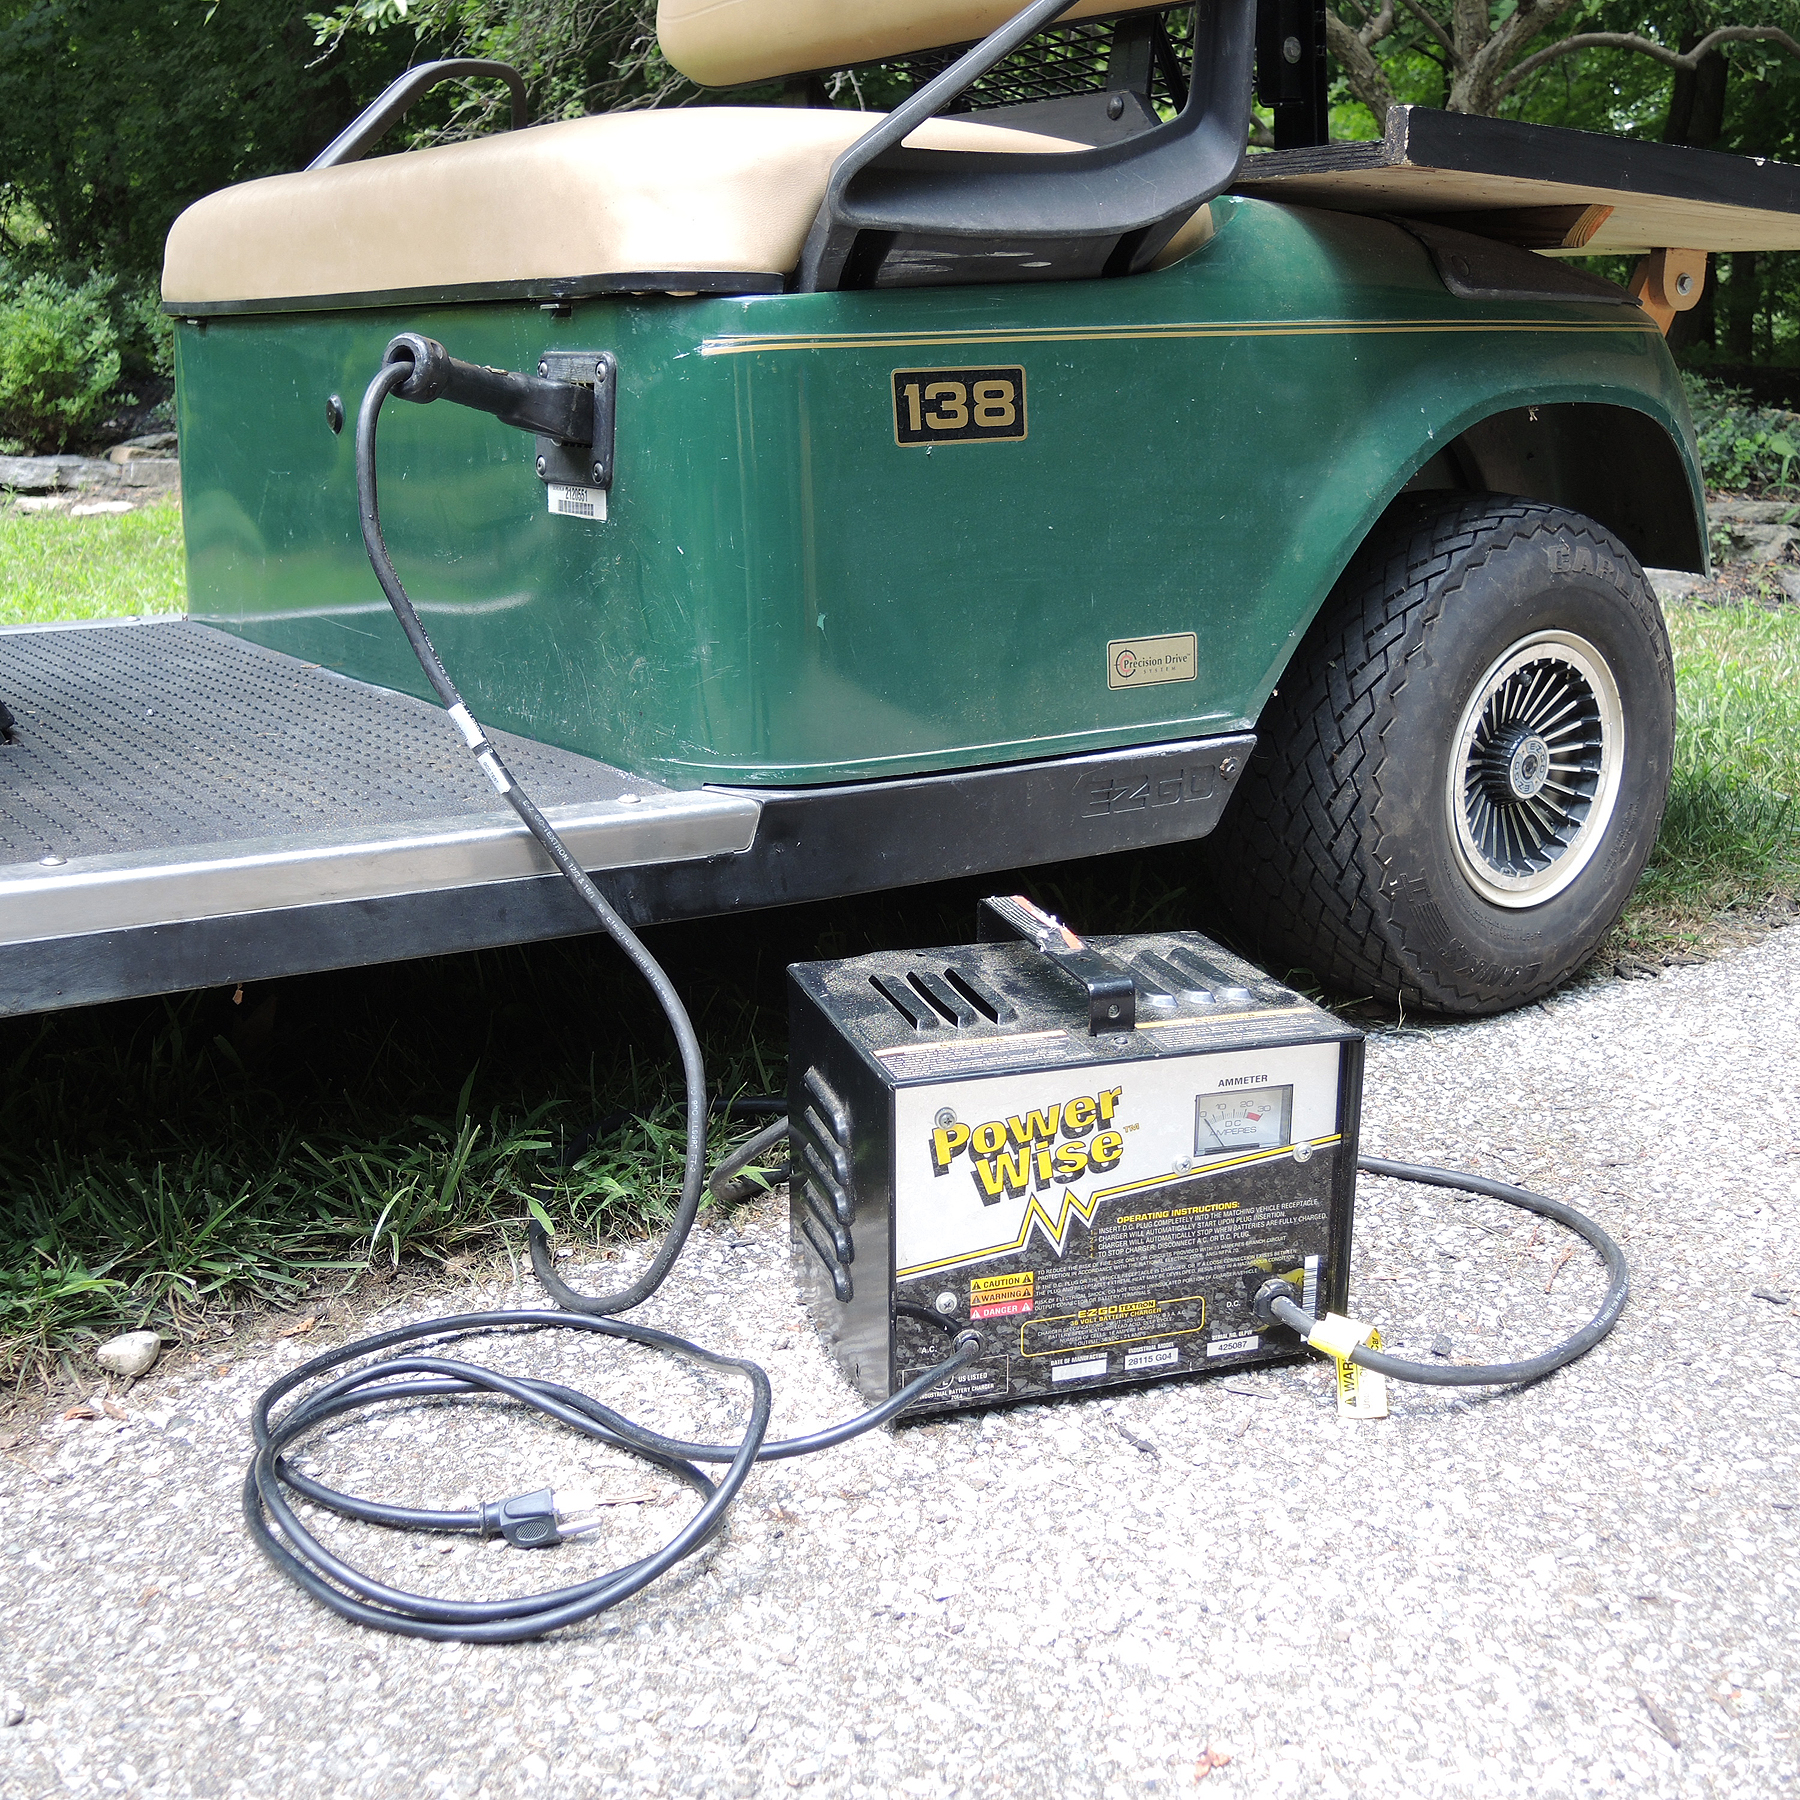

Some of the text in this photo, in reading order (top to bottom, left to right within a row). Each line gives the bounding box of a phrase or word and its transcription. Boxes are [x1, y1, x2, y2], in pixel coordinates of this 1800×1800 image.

[904, 380, 1016, 431] 138
[1123, 654, 1188, 669] Precision Drive
[1143, 666, 1177, 674] SYSTEM
[1218, 1074, 1267, 1086] AMMETER
[932, 1086, 1123, 1166] Power
[1209, 1125, 1256, 1138] AMPERES
[974, 1130, 1124, 1196] Wise
[1098, 1225, 1120, 1234] INSERT
[1136, 1220, 1152, 1229] PLUG
[1153, 1215, 1193, 1226] COMPLETELY
[1194, 1213, 1209, 1221] INTO
[1222, 1206, 1254, 1217] MATCHING
[1255, 1203, 1279, 1212] VEHICLE
[1116, 1200, 1239, 1224] OPERATING INSTRUCTIONS:
[1098, 1232, 1126, 1242] CHARGER
[1128, 1230, 1144, 1238] WILL
[1146, 1223, 1195, 1235] AUTOMATICALLY
[1197, 1220, 1215, 1228] START
[1218, 1217, 1234, 1226] UPON
[1236, 1215, 1251, 1223] PLUG
[1098, 1240, 1127, 1250] CHARGER
[1128, 1237, 1144, 1246] WILL
[1145, 1230, 1195, 1243] AUTOMATICALLY
[1197, 1228, 1212, 1236] STOP
[1214, 1225, 1232, 1234] WHEN
[1234, 1220, 1264, 1231] BATTERIES
[1278, 1216, 1297, 1225] FULLY
[1107, 1248, 1124, 1256] STOP
[983, 1277, 1019, 1288] CAUTION
[981, 1290, 1021, 1302] WARNING
[983, 1304, 1017, 1316] DANGER
[1120, 1299, 1153, 1312] TEXTRON
[1226, 1299, 1240, 1308] D.C.
[921, 1345, 937, 1354] A.C.
[1217, 1340, 1247, 1351] 425087
[1071, 1351, 1107, 1363] MANUFACTURE
[1128, 1352, 1172, 1366] 28115 G04
[967, 1372, 987, 1380] LISTED
[948, 1386, 970, 1395] BATTERY
[971, 1382, 994, 1391] CHARGER
